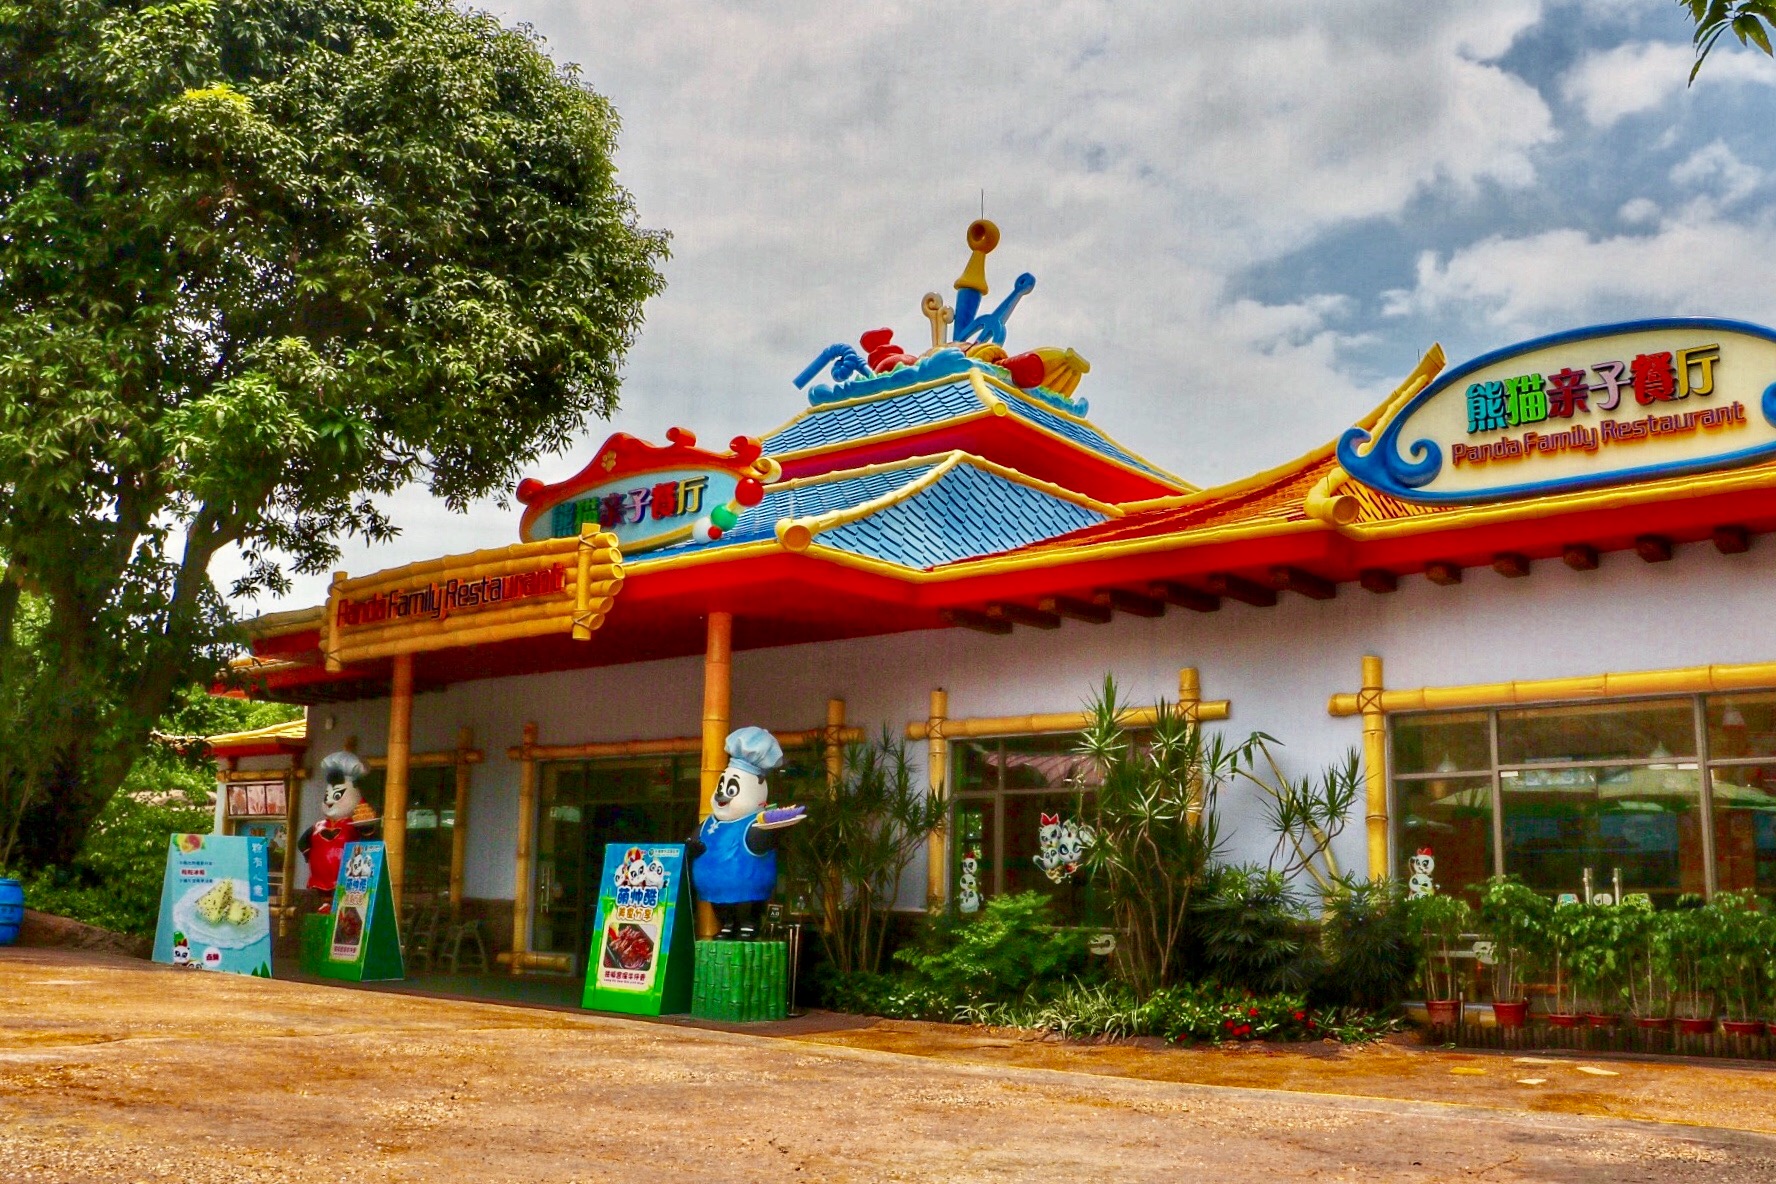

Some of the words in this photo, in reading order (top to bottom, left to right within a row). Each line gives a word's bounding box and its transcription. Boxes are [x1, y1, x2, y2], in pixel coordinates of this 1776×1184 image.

[1465, 343, 1720, 434] 熊猫亲子餐厅
[1452, 439, 1522, 465] Panda
[1523, 425, 1598, 455] Family
[1601, 402, 1746, 442] Restaurant
[387, 582, 446, 621] Family
[446, 563, 565, 609] Restaurant
[616, 886, 659, 907] 萌帅酷
